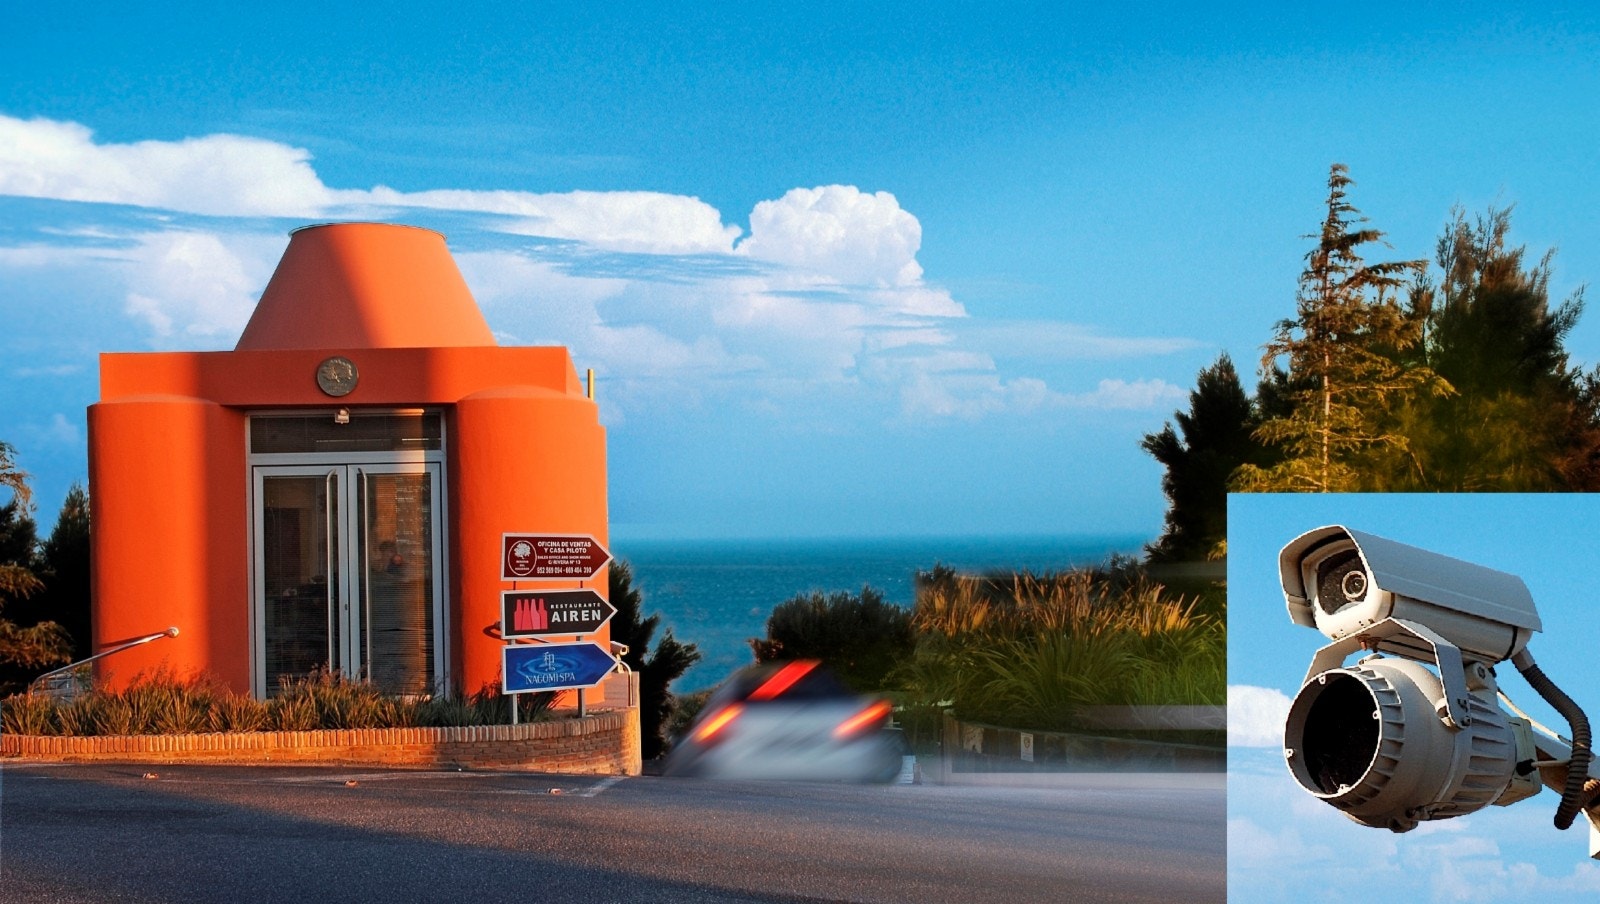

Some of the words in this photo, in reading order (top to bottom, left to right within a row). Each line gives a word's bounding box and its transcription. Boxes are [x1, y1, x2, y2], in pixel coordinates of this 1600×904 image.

[551, 609, 601, 622] AIREN
[525, 673, 558, 684] NAGOMI
[559, 672, 576, 682] SPA
